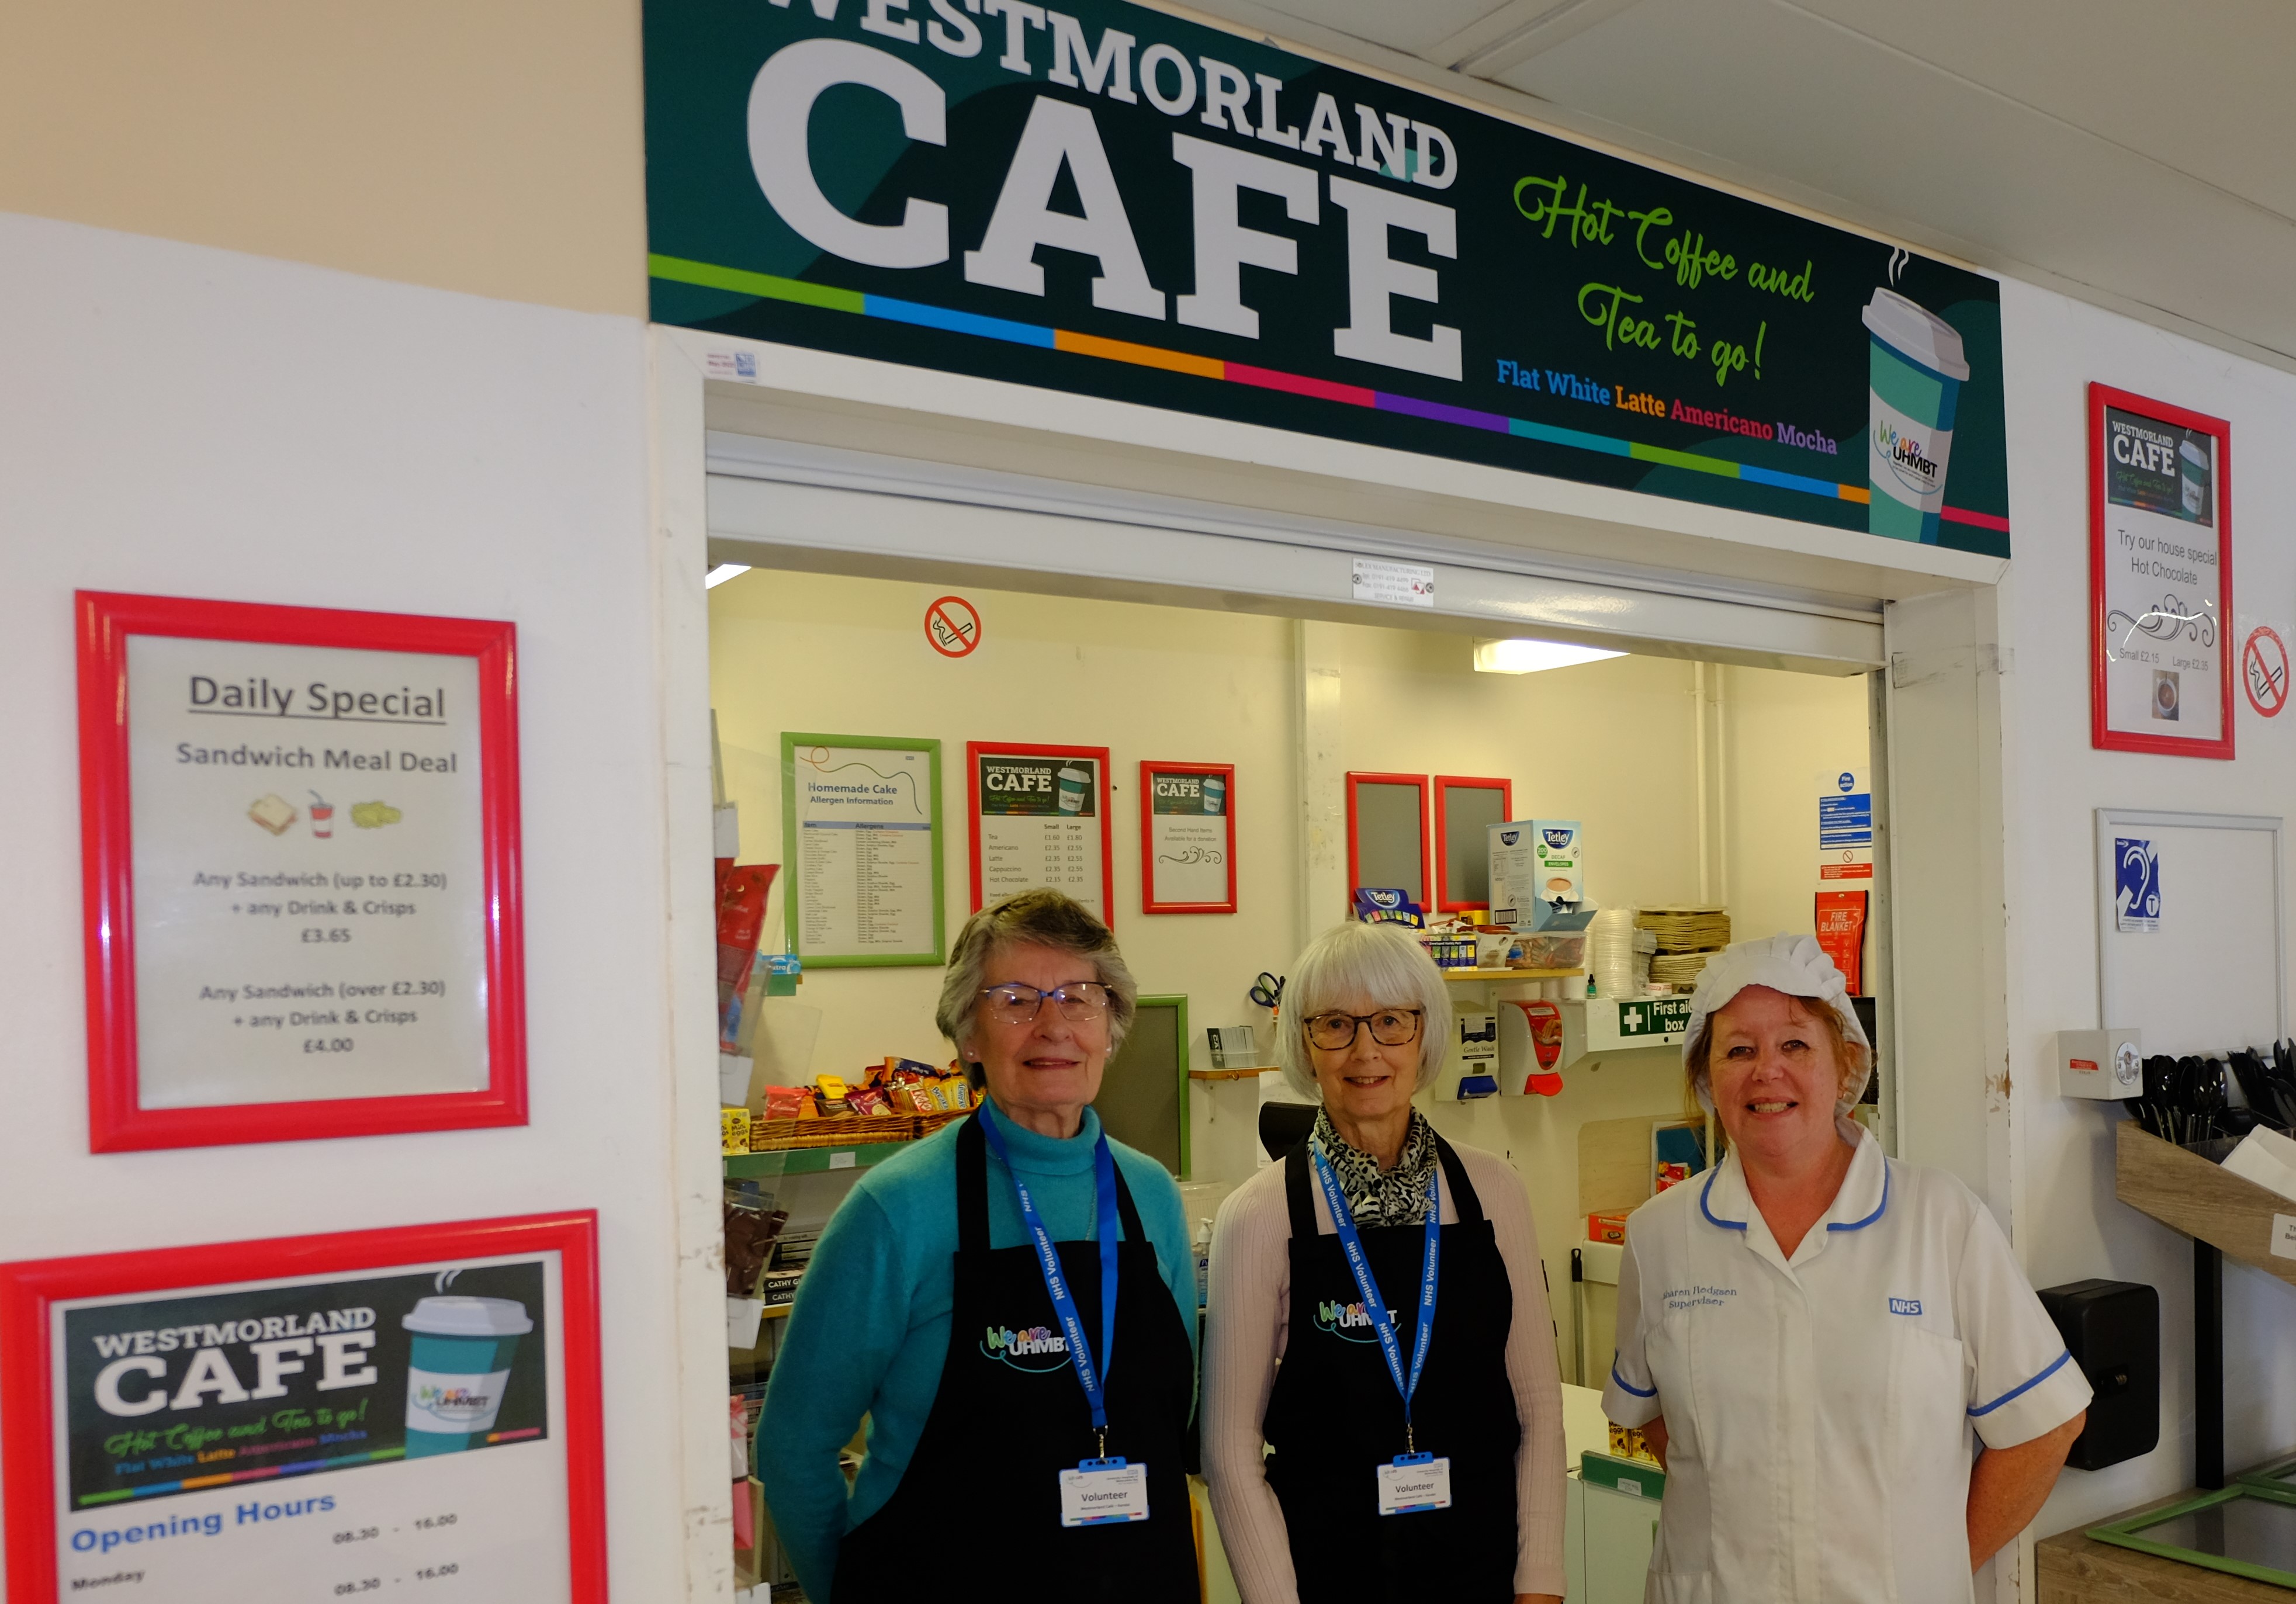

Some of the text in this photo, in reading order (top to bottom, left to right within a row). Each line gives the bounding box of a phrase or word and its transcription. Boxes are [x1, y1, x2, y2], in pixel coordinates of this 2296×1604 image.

[746, 37, 1463, 382] CAFE
[1513, 175, 1815, 303] Hot Coffee and
[1577, 281, 1767, 387] Tea to go!
[1497, 359, 1838, 456] Flat White Latte Americano Mocha
[1879, 420, 1922, 458] We are
[2112, 421, 2173, 448] WESTMORLAND
[1893, 446, 1938, 478] UHMBT
[2113, 434, 2176, 477] CAFE
[2118, 529, 2217, 566] Try our house special
[2131, 557, 2198, 585] Hot Chocolate
[2120, 647, 2160, 663] Small £2.15
[2173, 656, 2208, 671] Large £2.35
[190, 675, 445, 720] Daily Special
[176, 742, 458, 774] Sandwich Meal Deal
[986, 766, 1052, 775] WESTMORLAND
[808, 782, 898, 795] Homemade Cake
[986, 773, 1052, 792] CAFE
[1156, 783, 1200, 797] CAFE
[810, 796, 894, 806] Allergen Information
[1502, 833, 1518, 842] Tetley
[1546, 830, 1570, 845] Tetley
[193, 871, 448, 895] Any Sandwich (up to £2.30)
[247, 898, 417, 919] any Drink & Crisps
[1372, 892, 1395, 903] Tetley
[1820, 921, 1853, 932] BLANKET
[1831, 912, 1847, 921] FIRE
[300, 927, 352, 945] £3.65
[199, 980, 446, 1004] Any Sandwich (over £2.30)
[249, 1012, 285, 1029] any
[289, 1009, 339, 1028] Drink
[344, 1010, 359, 1026] &
[363, 1007, 418, 1027] Crisps
[1653, 1002, 1677, 1016] First
[1665, 1018, 1684, 1031] box
[303, 1037, 354, 1054] £4.00
[1021, 1190, 1032, 1212] NHS
[1321, 1165, 1346, 1227] NHS Volunteer
[1034, 1226, 1065, 1300] NHS Volunteer
[1347, 1241, 1377, 1308] NHS Volunteer
[1424, 1238, 1437, 1307] NHS Volunteer
[768, 1279, 792, 1288] CATHY
[1693, 1286, 1737, 1296] Hodgson
[772, 1292, 794, 1301] CATHY
[1669, 1296, 1724, 1309] Supervisor
[1892, 1299, 1920, 1314] NHS
[1319, 1300, 1346, 1322] We
[93, 1307, 378, 1359] WESTMORLAND
[986, 1325, 1051, 1349] We are
[1065, 1316, 1095, 1392] NHS Volunteer
[1379, 1322, 1405, 1391] NHS Volunteer
[1409, 1322, 1429, 1394] NHS Volunteer
[93, 1328, 379, 1418] CAFE
[196, 1447, 237, 1463] Latte
[1081, 1491, 1128, 1502] Volunteer
[1395, 1483, 1435, 1493] Volunteer
[70, 1492, 337, 1556] Opening Hours
[333, 1513, 459, 1546] 08.30 16.00
[71, 1566, 146, 1596] Monday
[334, 1563, 460, 1598] 08.30 16.00
